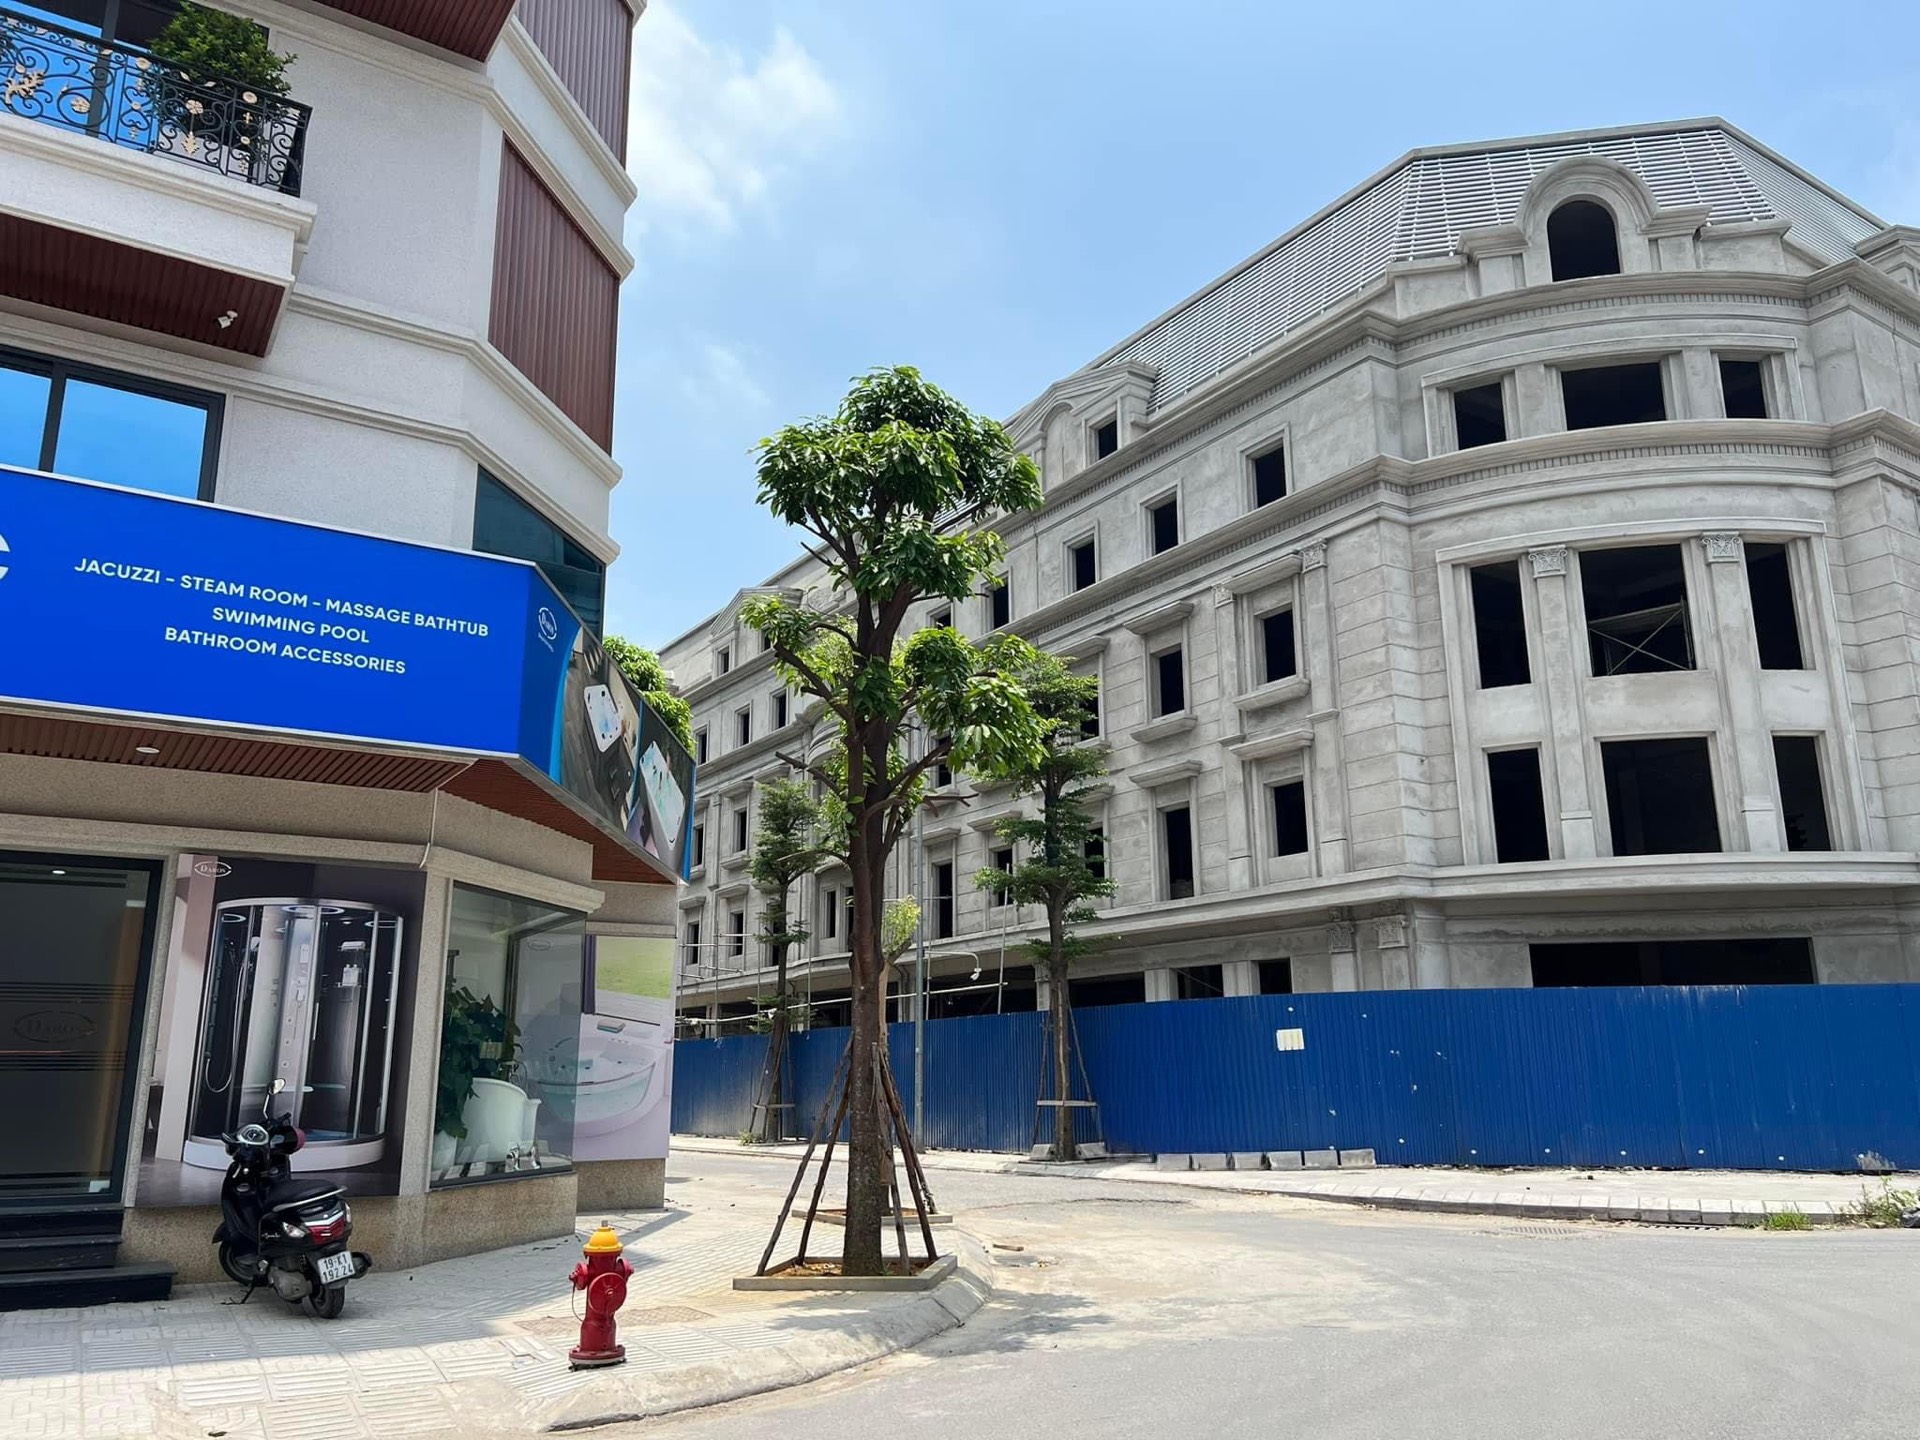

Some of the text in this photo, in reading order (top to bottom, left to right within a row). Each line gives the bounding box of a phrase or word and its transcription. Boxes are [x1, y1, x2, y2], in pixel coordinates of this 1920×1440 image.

[74, 558, 161, 584] JACUZZI
[180, 575, 245, 597] STEAM
[249, 586, 308, 607] ROOM
[326, 599, 411, 624] MASSAGE
[414, 613, 489, 637] BATHTUB
[212, 607, 370, 643] SWIMMING POOL
[164, 627, 406, 674] BATHROOM ACCESSORIES
[324, 1253, 347, 1270] 19-K1
